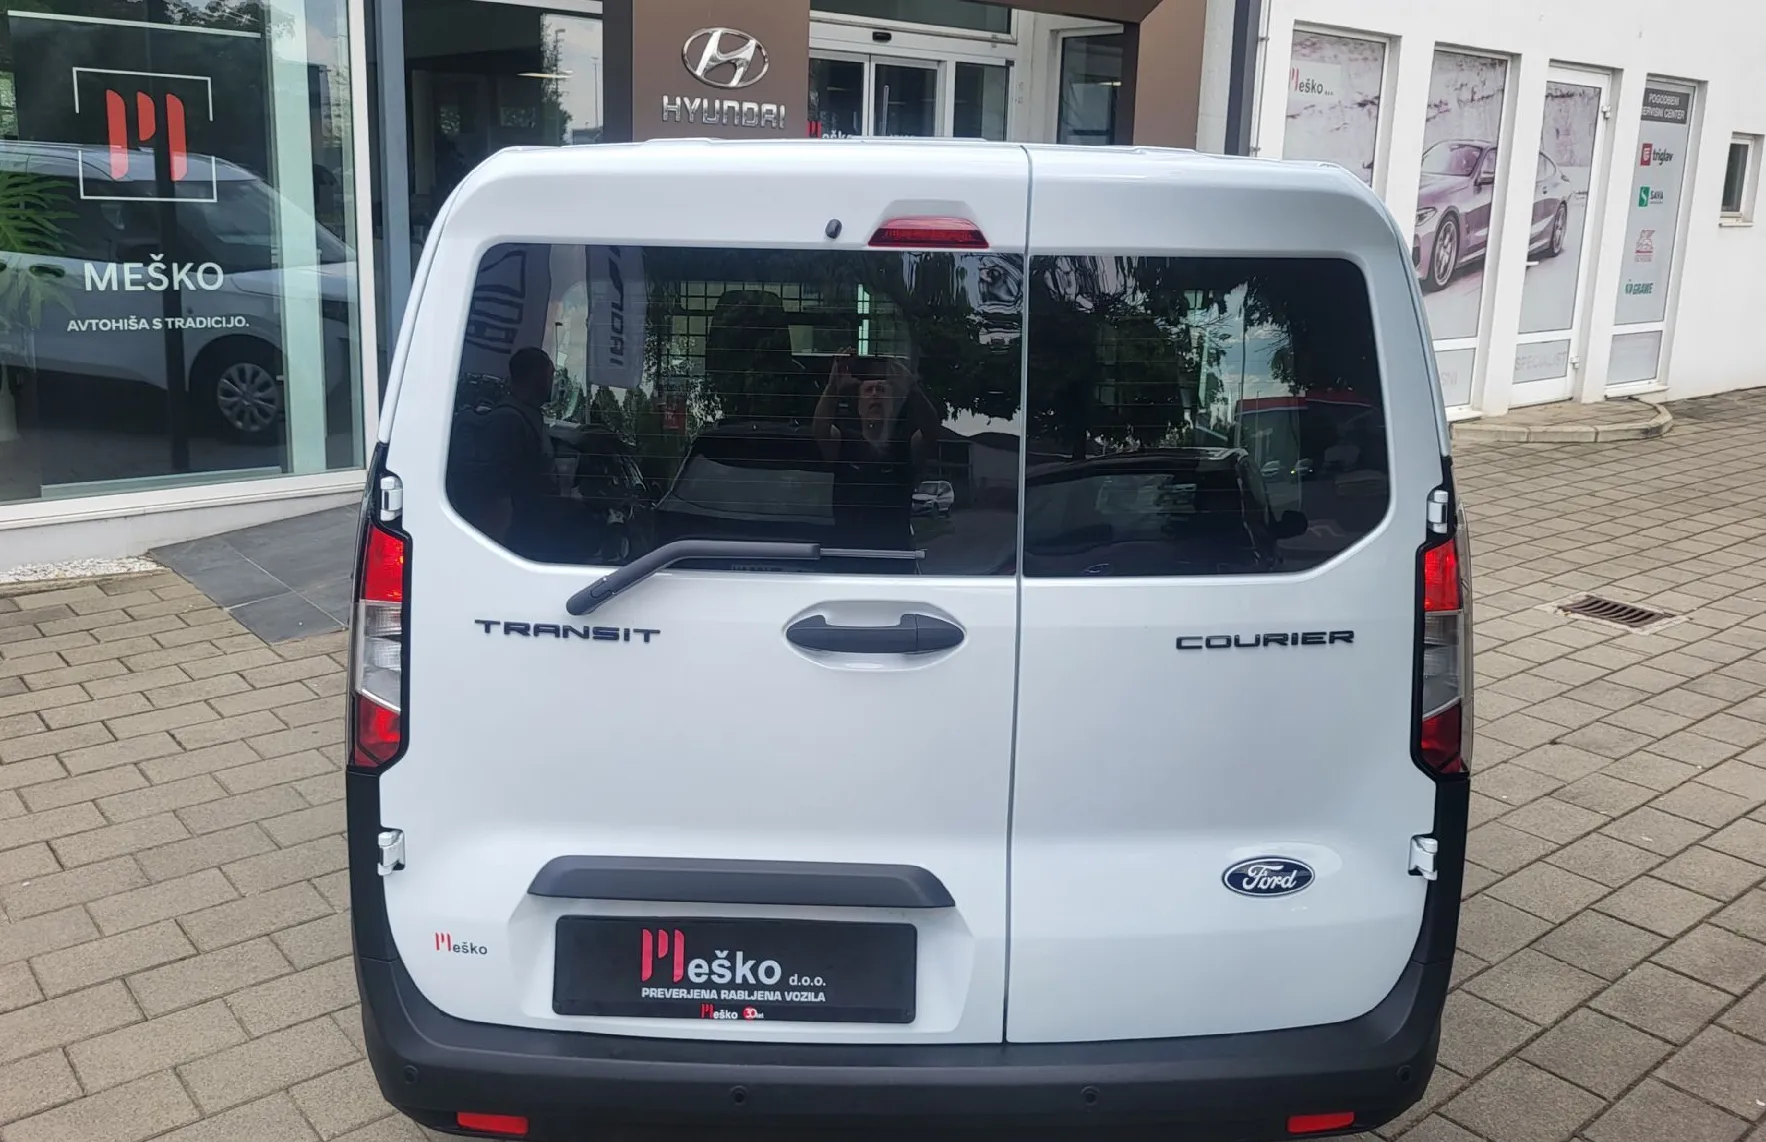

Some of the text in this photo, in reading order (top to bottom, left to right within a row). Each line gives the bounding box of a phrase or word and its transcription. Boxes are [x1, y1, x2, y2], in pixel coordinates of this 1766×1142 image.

[662, 95, 786, 129] HYUNDAI
[1664, 108, 1686, 120] CENTER
[1652, 148, 1674, 166] triglav
[83, 253, 225, 291] MEŠKO
[1632, 282, 1654, 295] GRAWE
[66, 315, 250, 332] AVTOHIŠA S TRADICIJO.
[474, 618, 661, 644] TRANSIT
[1175, 630, 1355, 651] COURIER
[1242, 864, 1298, 890] Ford
[788, 974, 827, 987] d.o.o.
[641, 987, 826, 1002] PREVERJENA RABLJENA VOZILA
